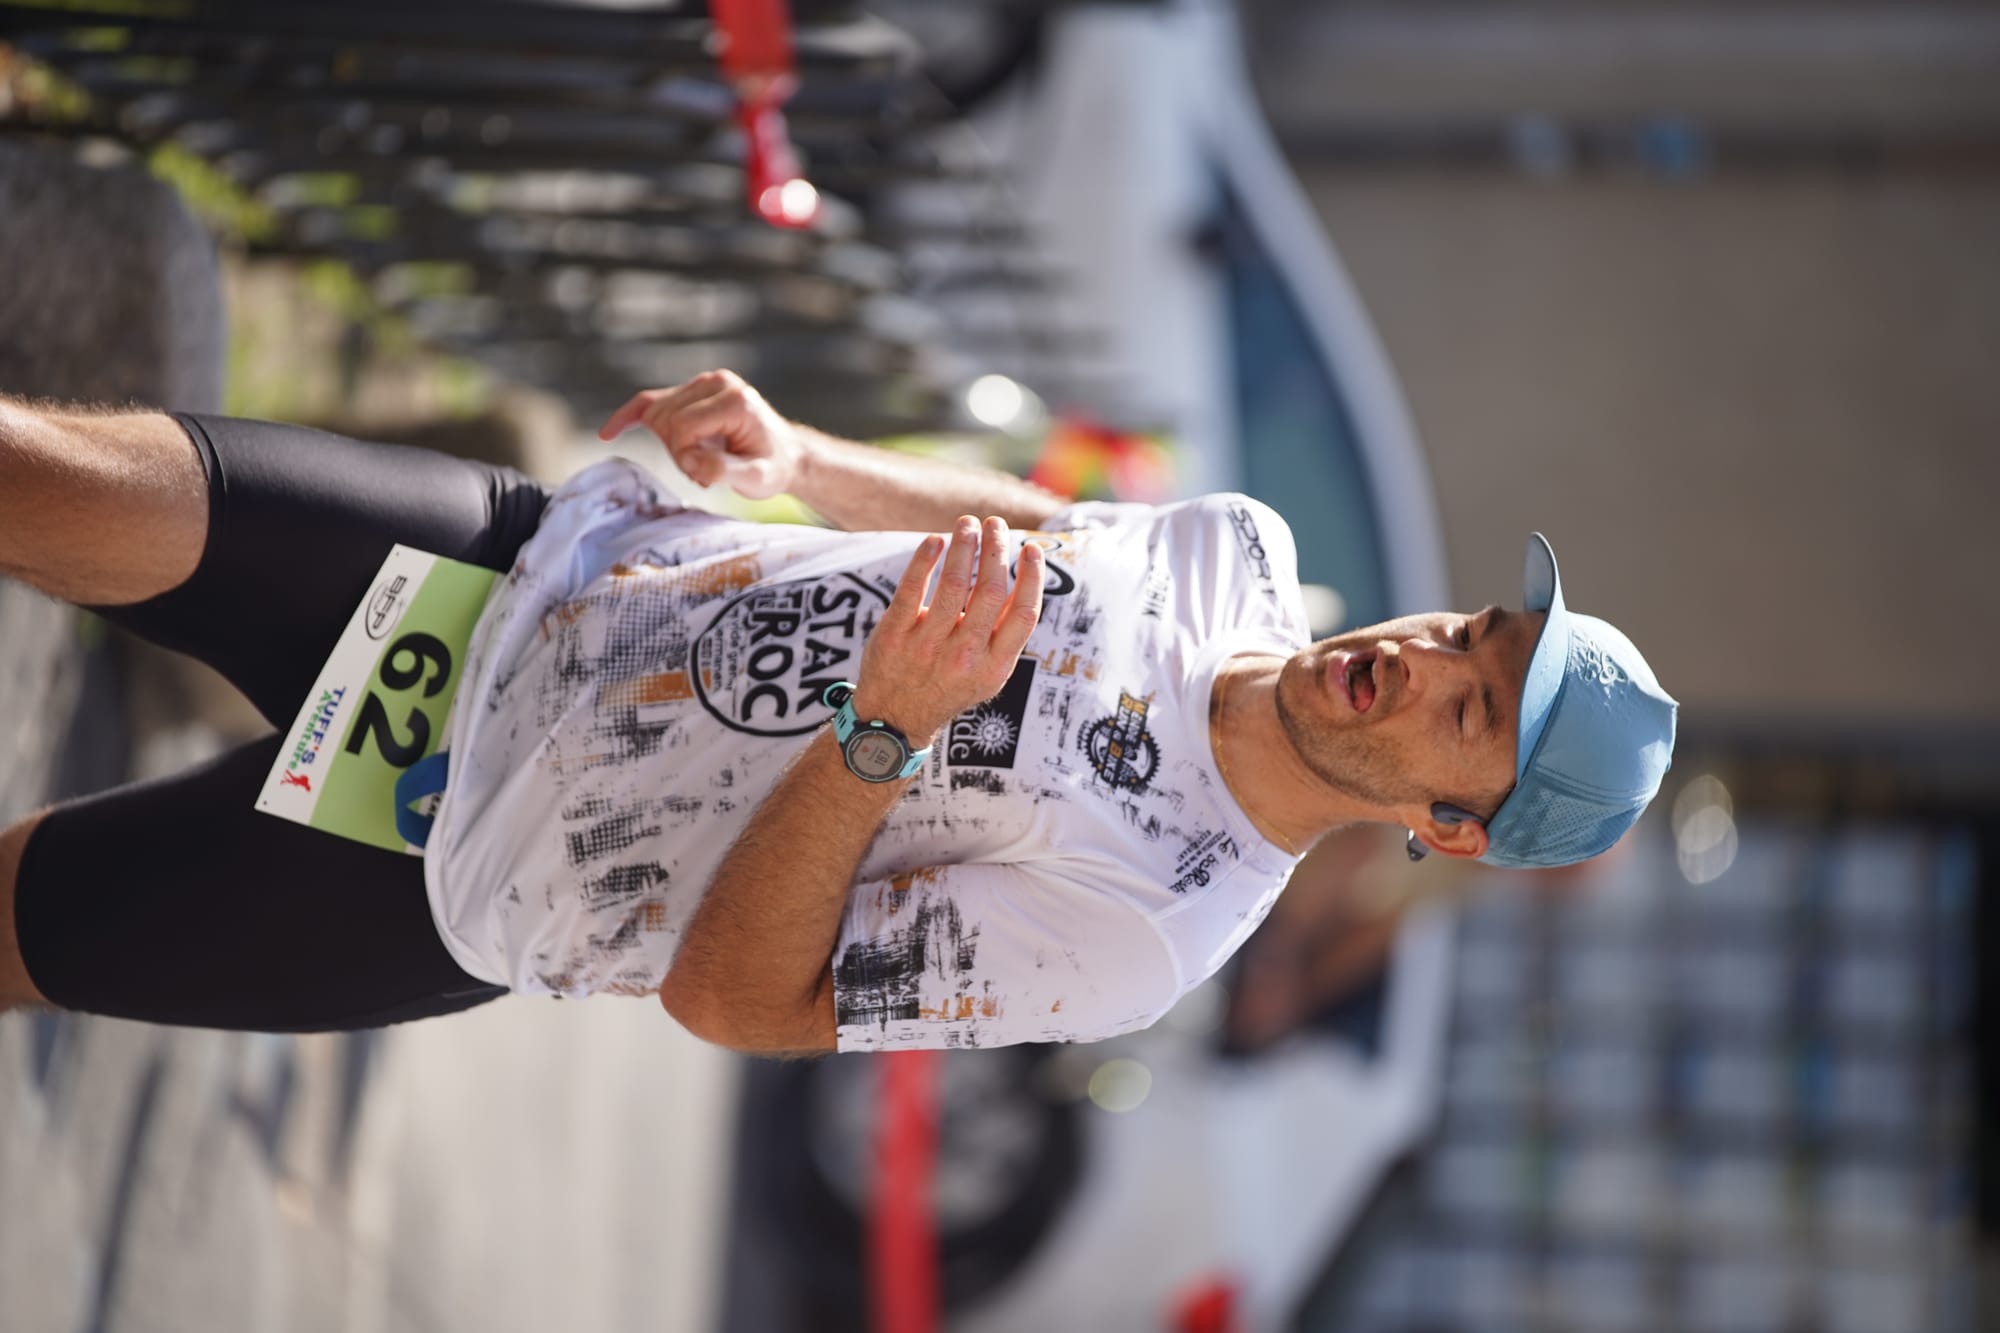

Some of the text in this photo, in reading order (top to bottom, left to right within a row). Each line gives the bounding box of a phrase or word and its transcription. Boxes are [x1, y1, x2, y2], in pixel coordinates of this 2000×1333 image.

[372, 576, 408, 629] BFP
[713, 626, 725, 692] ermanen
[796, 585, 861, 715] STAR
[301, 687, 347, 764] TUFF'S
[344, 632, 452, 768] 62
[1115, 693, 1133, 731] RUN
[1124, 700, 1147, 743] MENDE
[288, 691, 332, 770] Aventure
[951, 711, 980, 759] nde
[1102, 742, 1122, 784] BIKE
